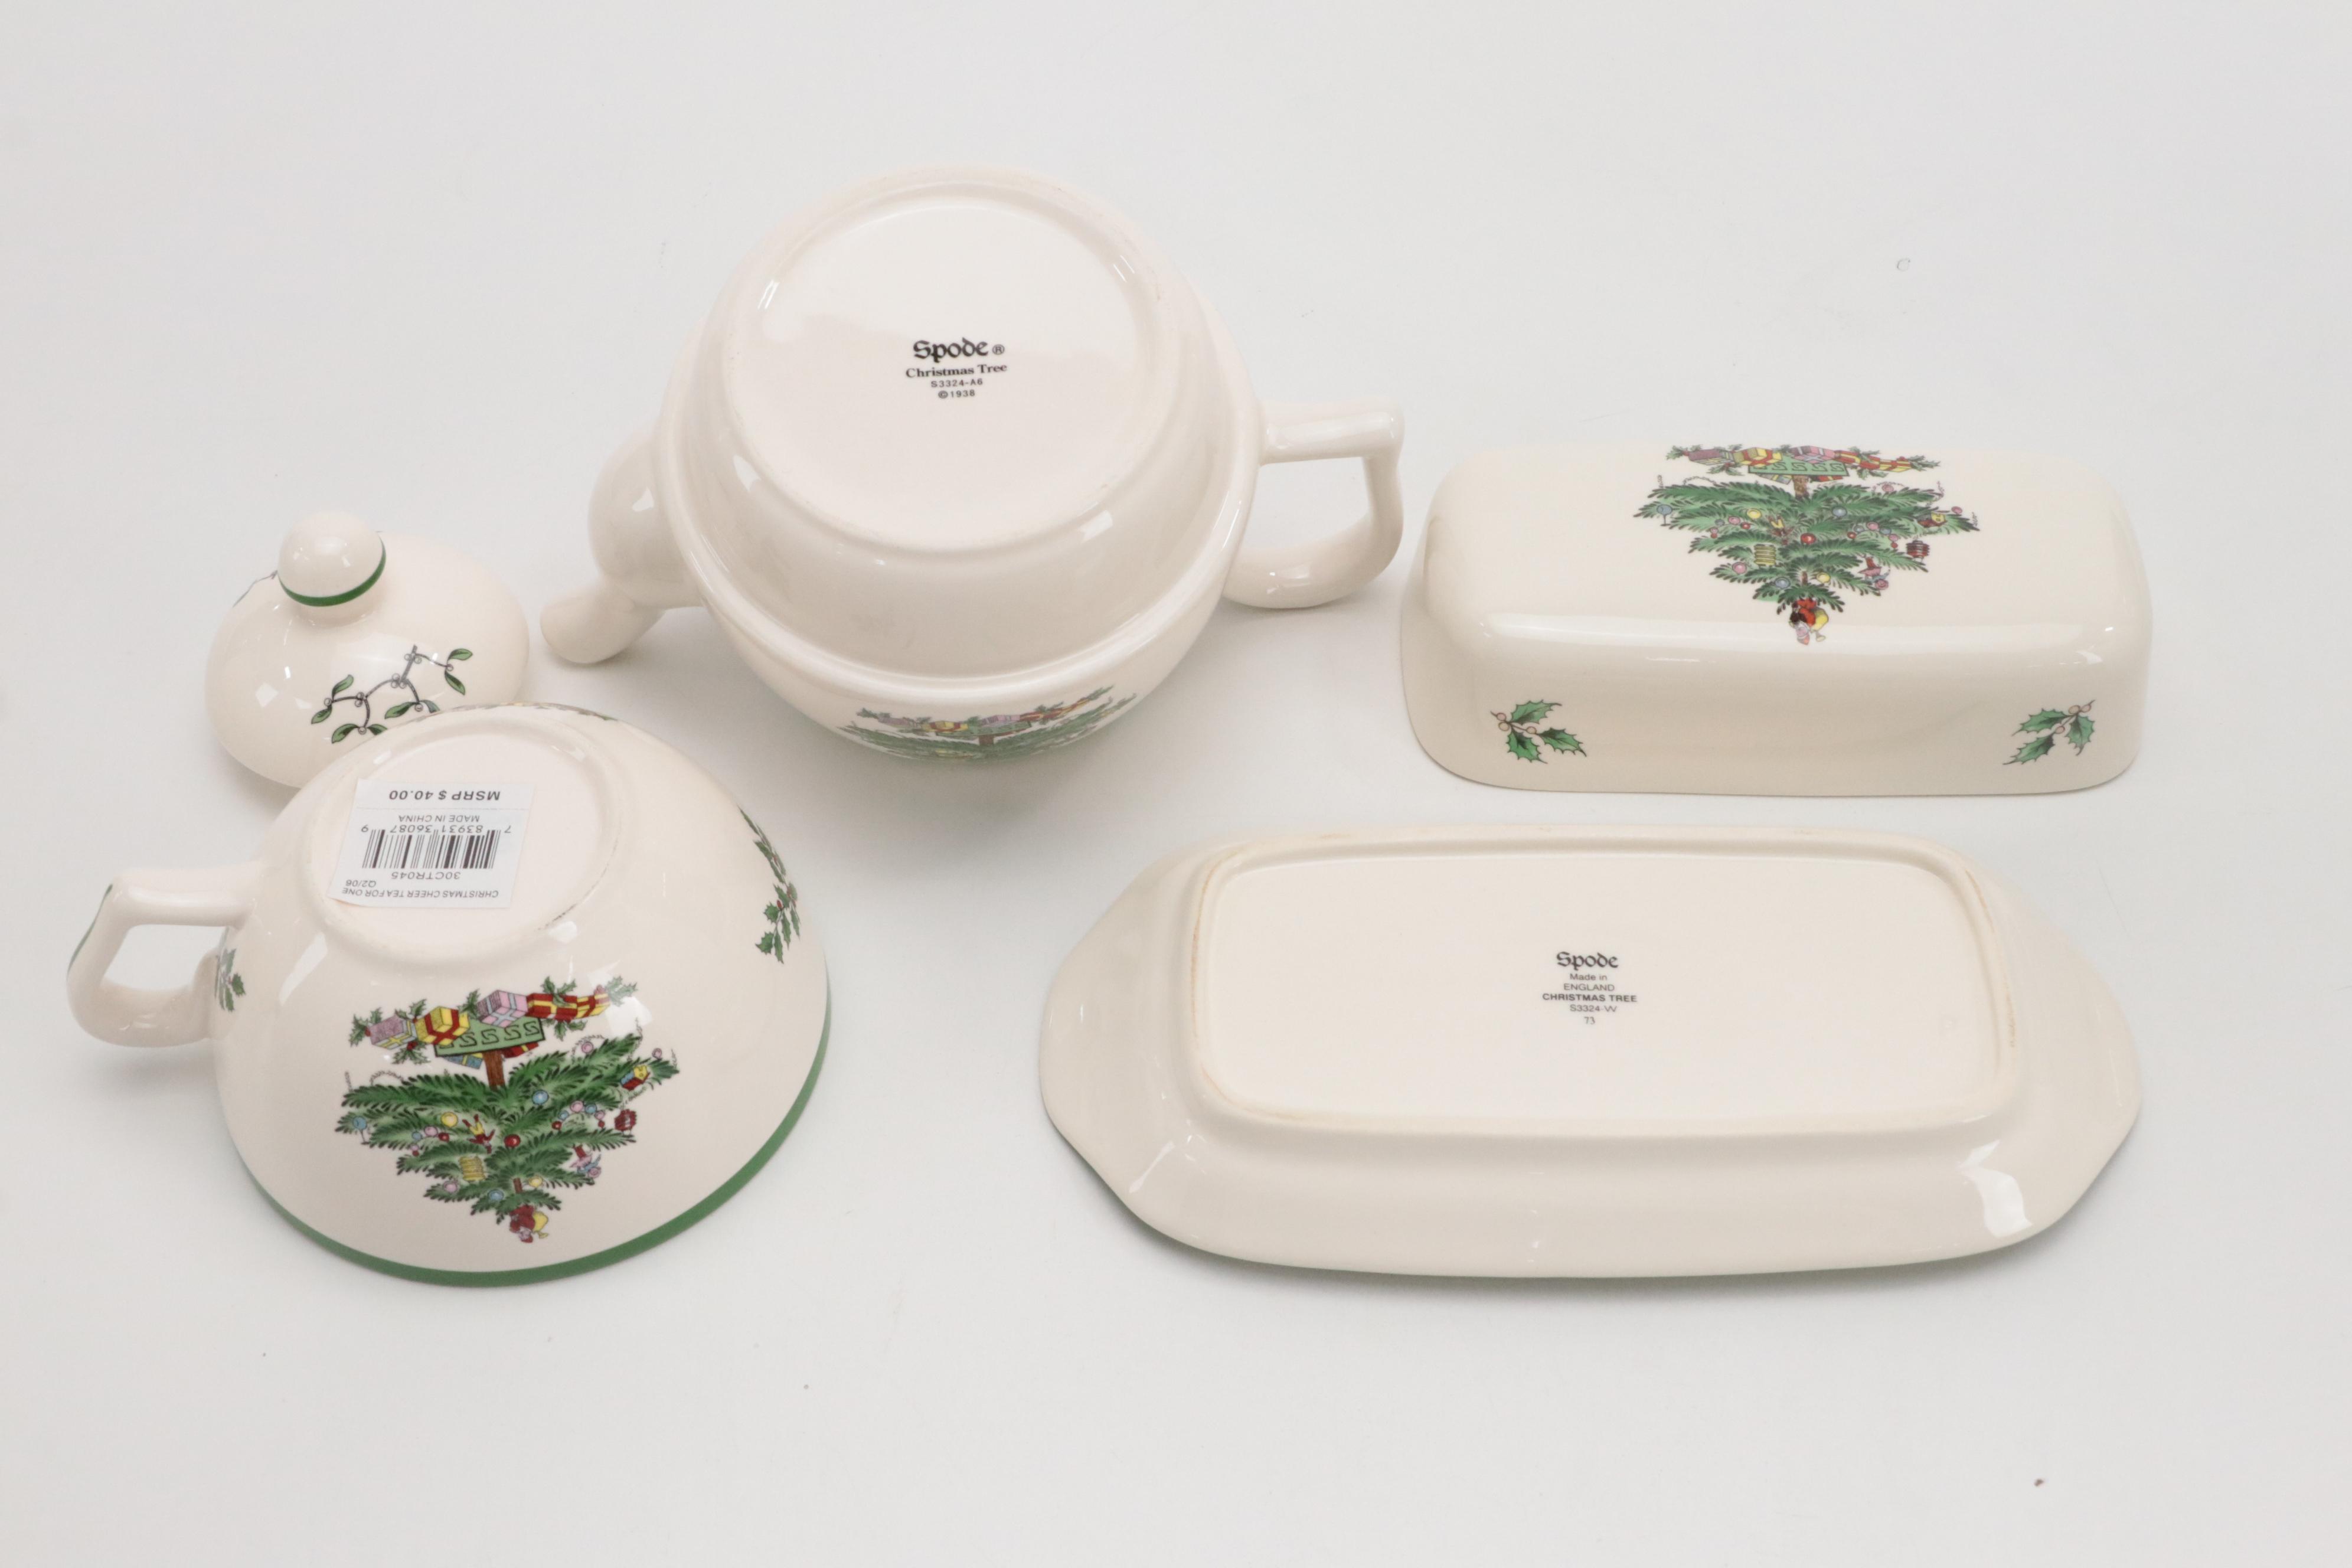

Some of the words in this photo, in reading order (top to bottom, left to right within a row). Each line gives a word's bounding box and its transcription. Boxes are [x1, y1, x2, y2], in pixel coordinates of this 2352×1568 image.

[913, 337, 988, 363] Spode
[906, 367, 974, 378] Christmas
[978, 364, 1007, 373] Tree
[931, 378, 983, 388] S3324-A6
[388, 790, 433, 800] 40.00
[438, 790, 447, 800] $
[451, 791, 501, 800] MSRP
[342, 888, 362, 896] ONE
[1556, 951, 1618, 971] Spode
